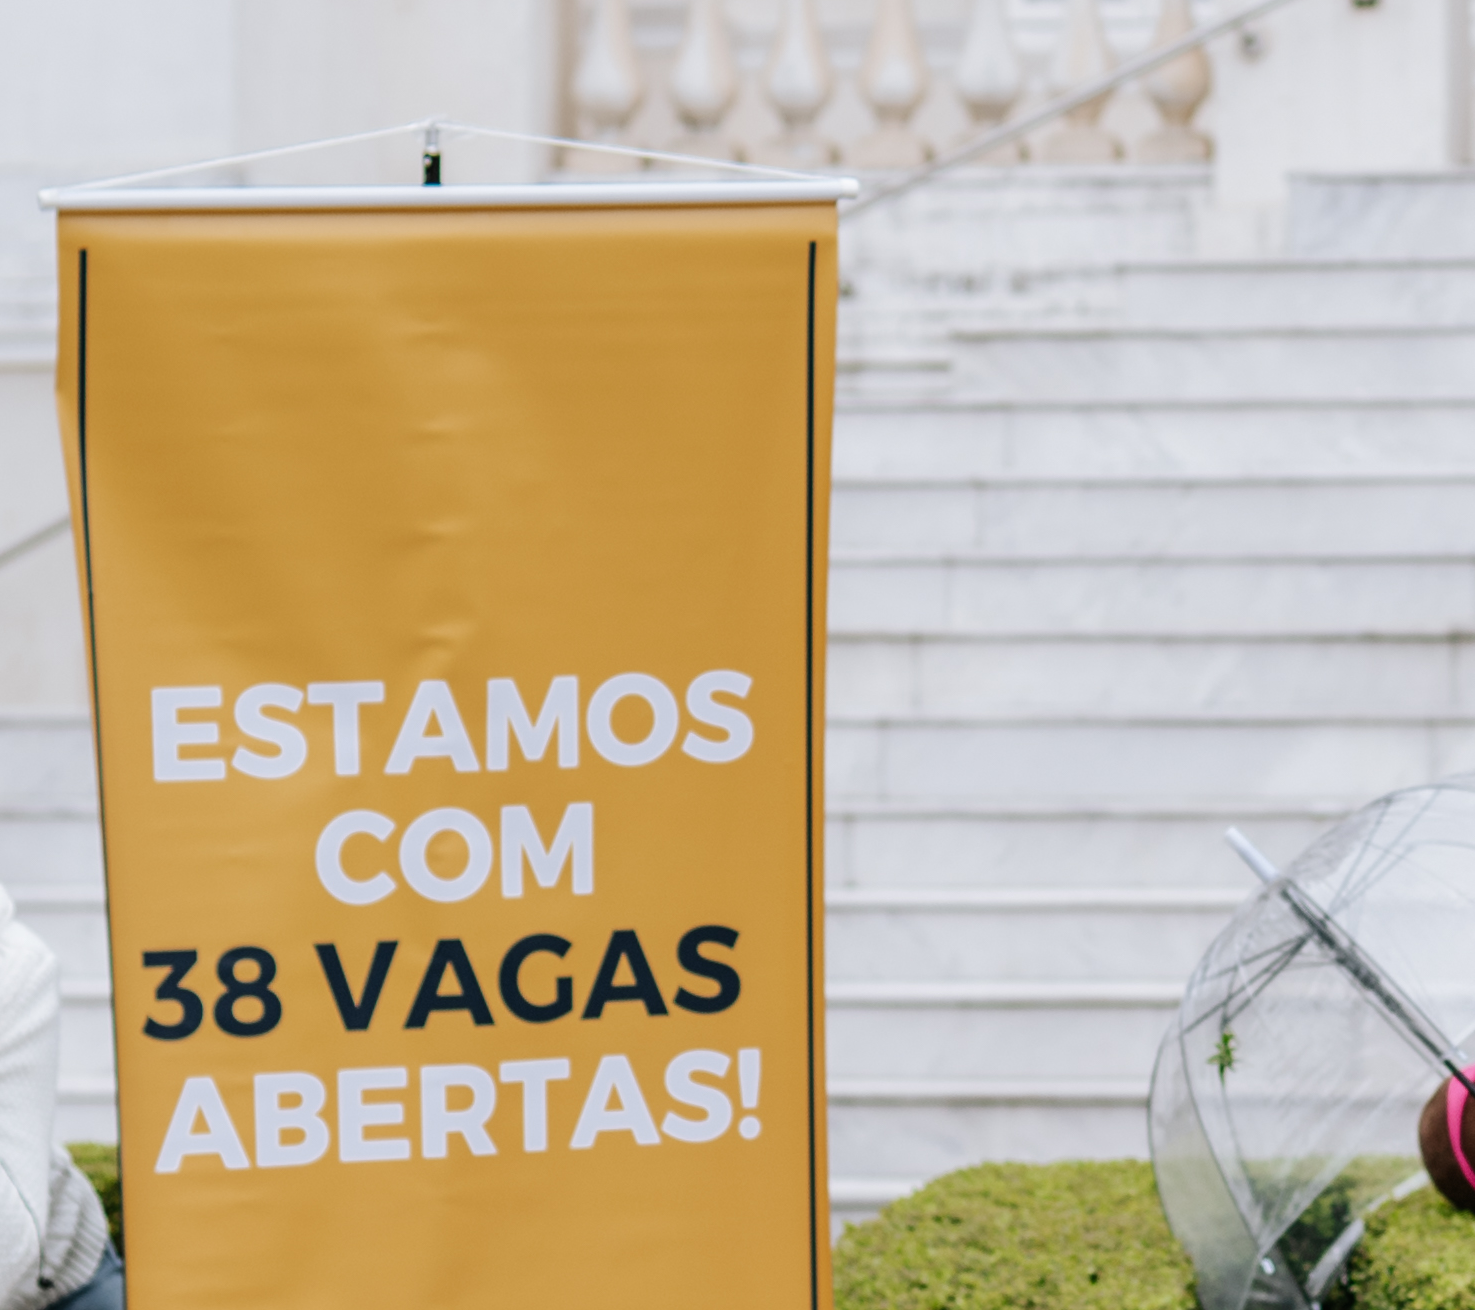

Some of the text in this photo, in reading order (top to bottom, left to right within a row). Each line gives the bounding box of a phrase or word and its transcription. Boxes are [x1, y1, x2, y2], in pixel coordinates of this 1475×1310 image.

[150, 669, 754, 783] ESTAMOS
[314, 802, 594, 907] COM
[141, 924, 743, 1042] 38 VAGAS
[155, 1047, 763, 1174] ABERTAS!
